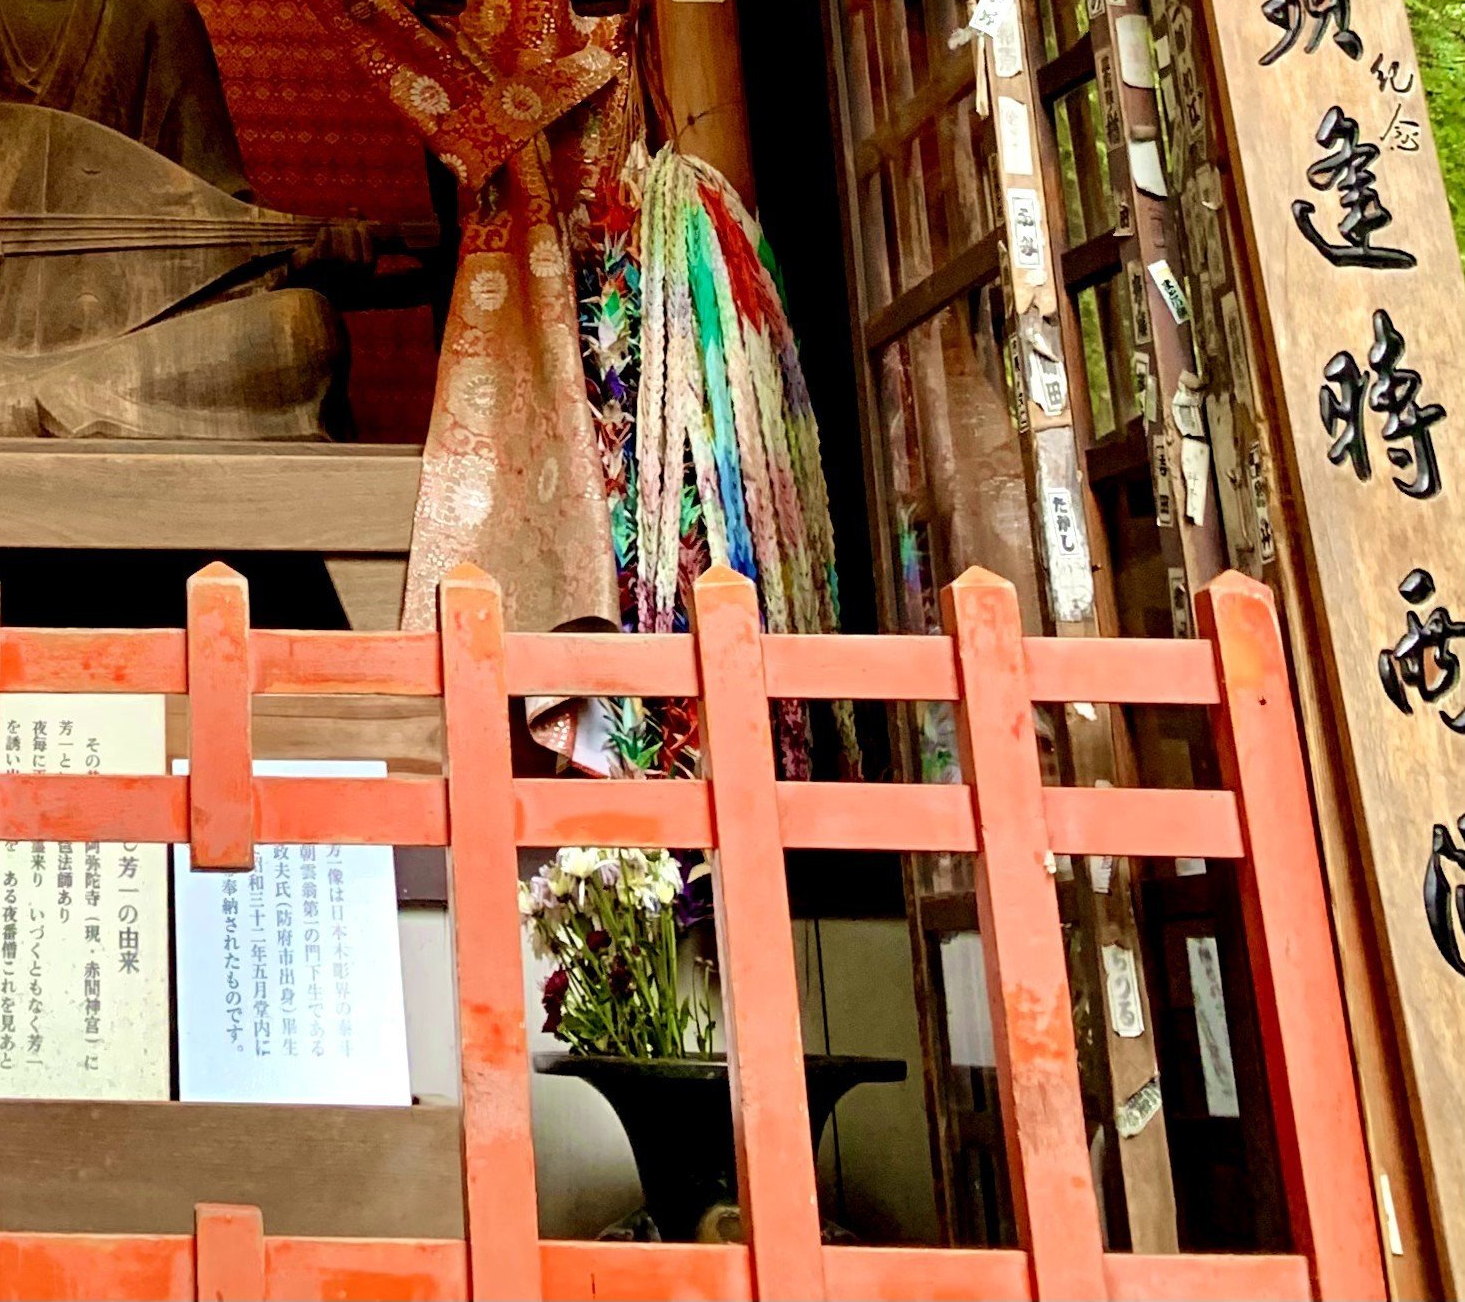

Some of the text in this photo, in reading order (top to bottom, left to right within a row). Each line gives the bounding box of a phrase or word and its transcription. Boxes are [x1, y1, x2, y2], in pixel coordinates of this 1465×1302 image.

[32, 720, 48, 774] 夜毎に
[58, 720, 74, 774] 芳一と
[85, 738, 101, 775] その
[117, 856, 141, 975] 芳一の由来
